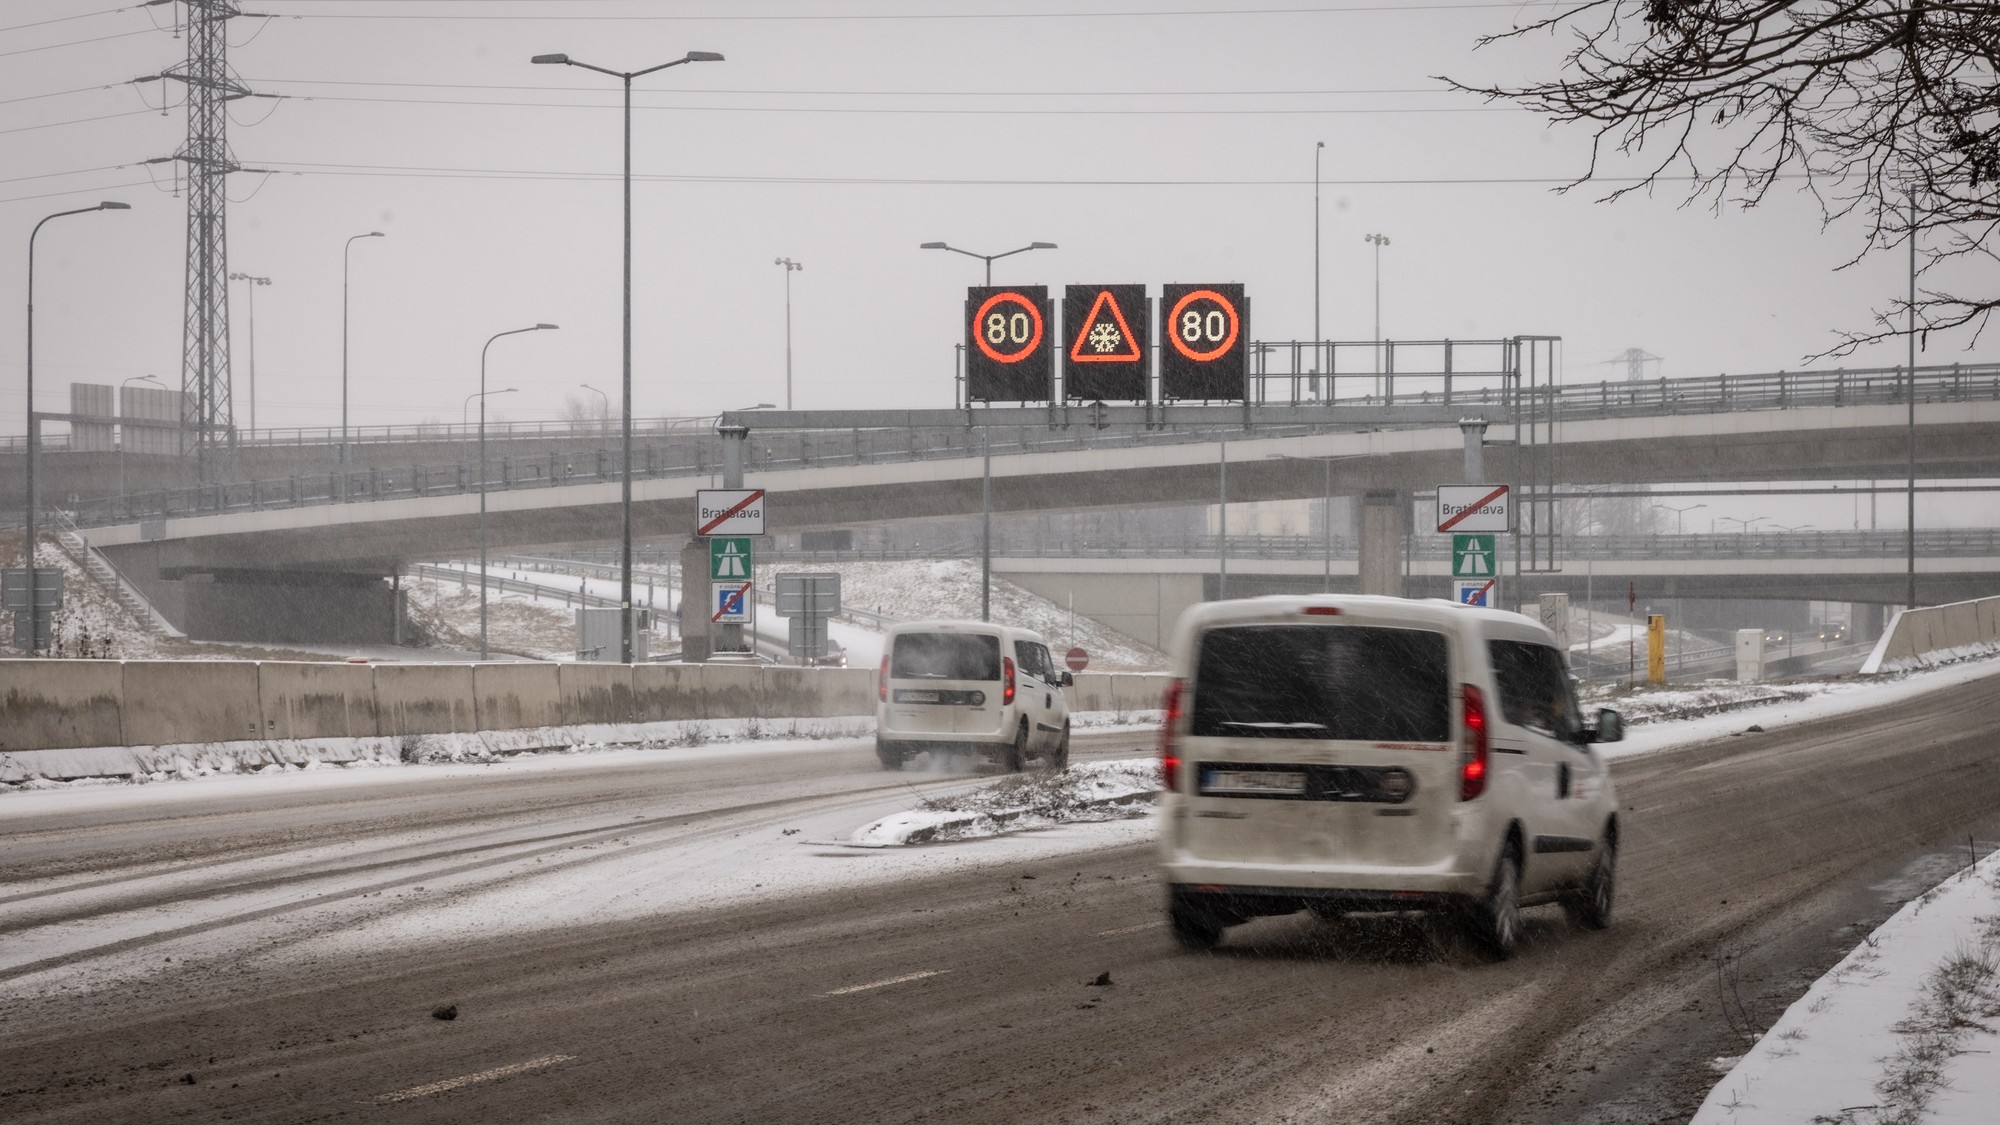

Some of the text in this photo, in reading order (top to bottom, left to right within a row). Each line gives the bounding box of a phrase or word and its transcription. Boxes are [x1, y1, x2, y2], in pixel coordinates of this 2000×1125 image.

[988, 313, 1028, 343] 80
[1183, 311, 1224, 341] 80
[702, 507, 759, 518] Bratislava
